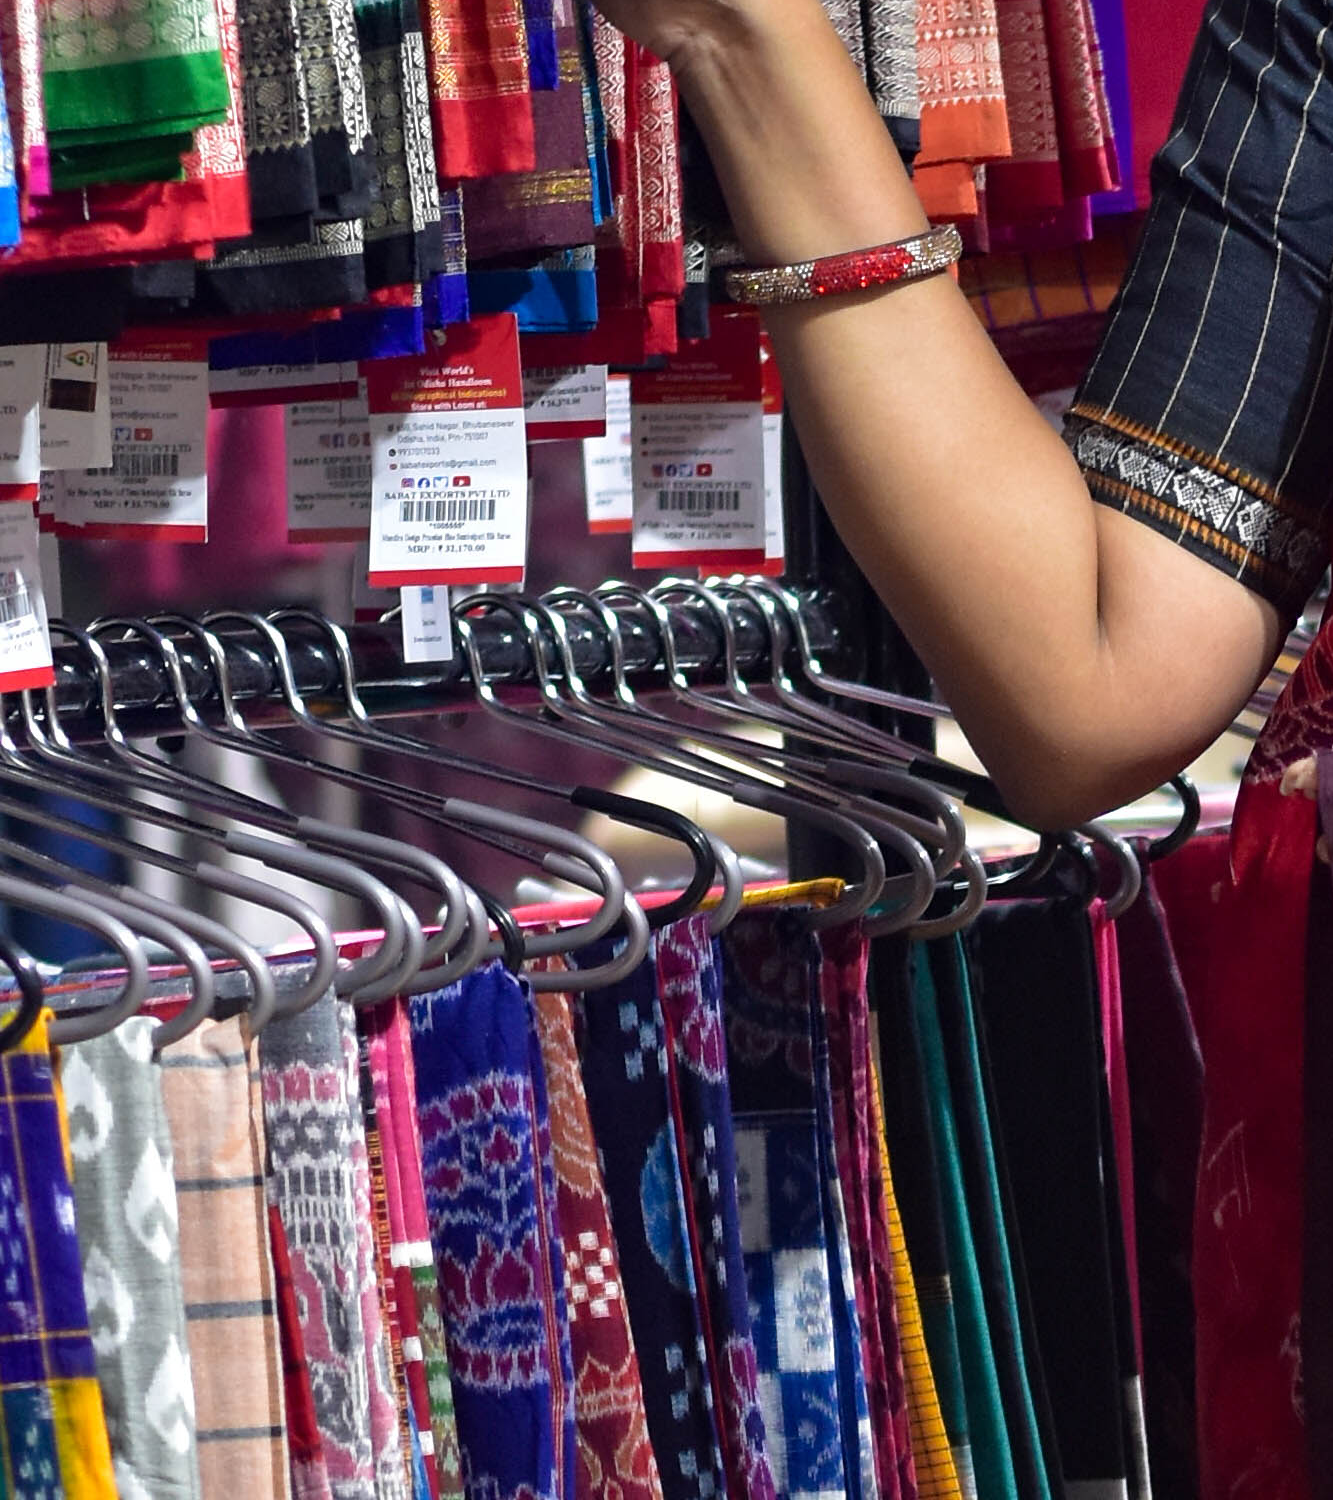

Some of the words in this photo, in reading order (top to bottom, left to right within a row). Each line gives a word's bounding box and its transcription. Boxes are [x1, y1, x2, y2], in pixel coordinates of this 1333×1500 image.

[442, 366, 474, 375] World's
[448, 377, 492, 387] Handloom
[411, 401, 432, 411] Store
[434, 401, 451, 410] with
[452, 401, 475, 410] Loom
[384, 492, 416, 500] SABAT
[420, 490, 466, 500] EXPORTS
[468, 490, 487, 499] PVT
[490, 489, 511, 498] LTD
